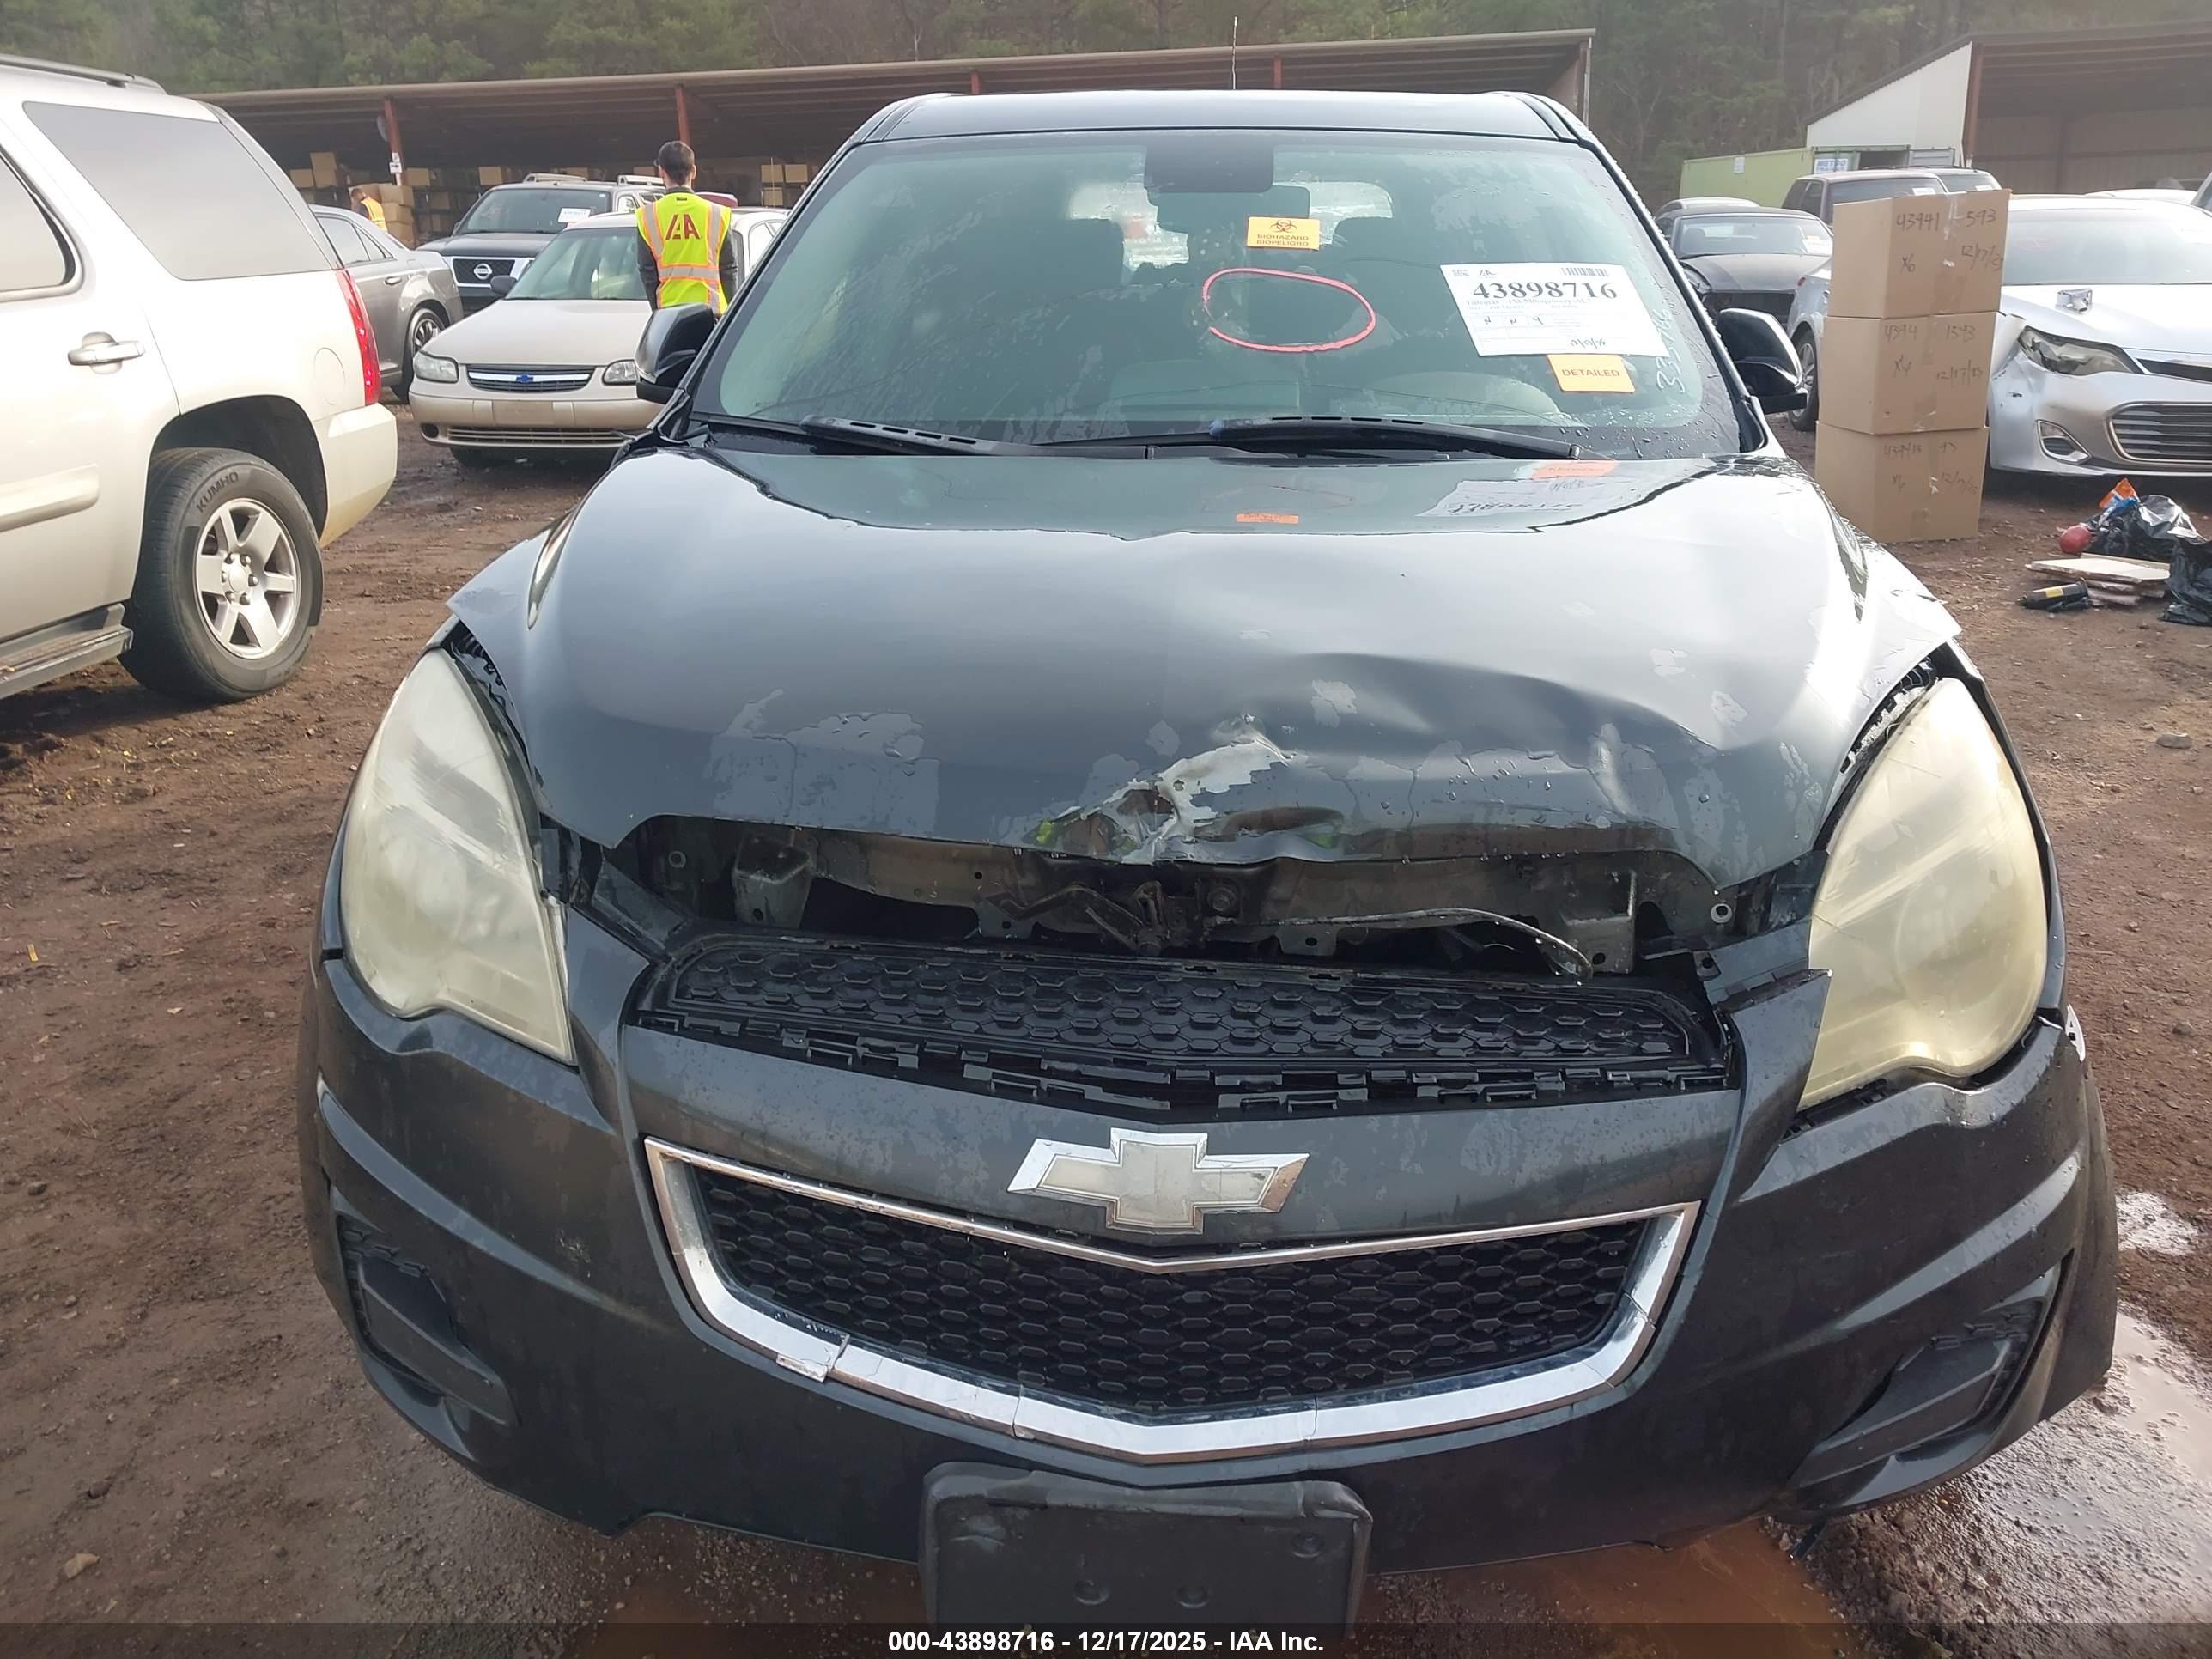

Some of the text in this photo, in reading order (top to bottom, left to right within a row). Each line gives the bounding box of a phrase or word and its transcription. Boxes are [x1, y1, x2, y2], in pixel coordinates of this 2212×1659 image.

[1473, 281, 1618, 299] 43898716
[1561, 368, 1620, 377] DETAILED
[196, 471, 240, 514] KUMHO
